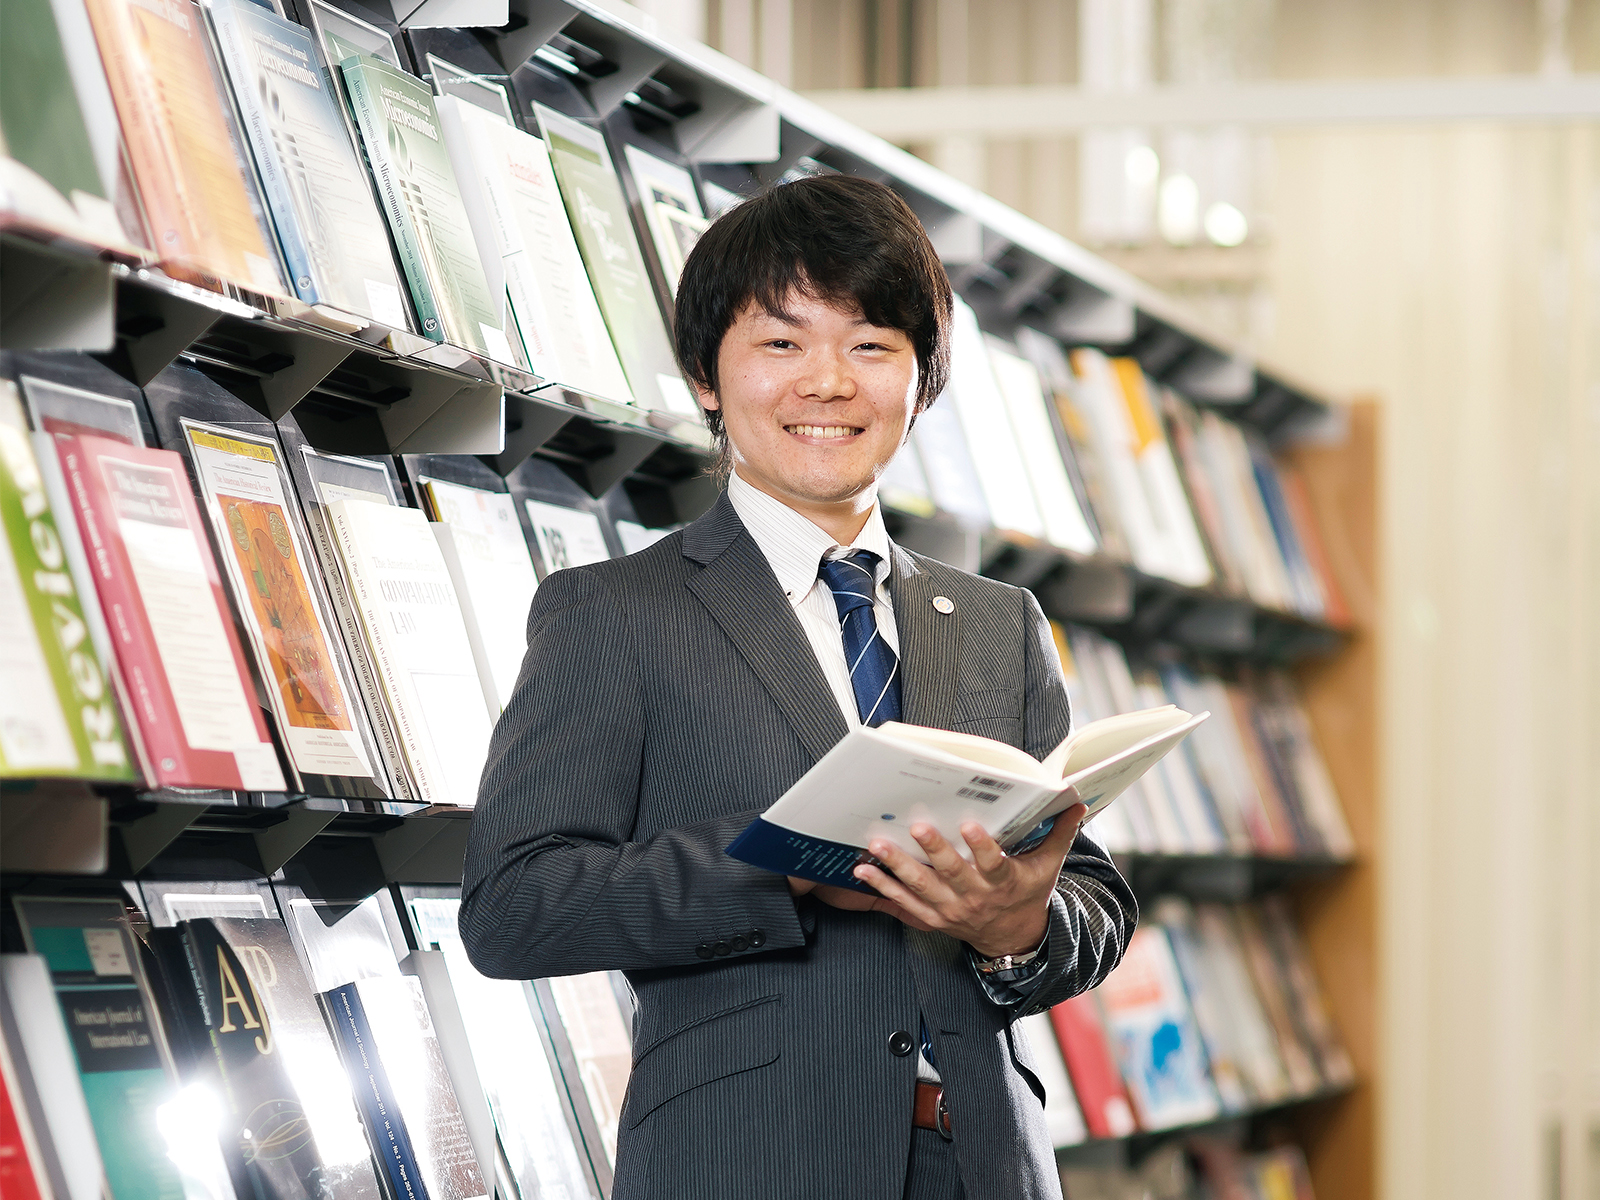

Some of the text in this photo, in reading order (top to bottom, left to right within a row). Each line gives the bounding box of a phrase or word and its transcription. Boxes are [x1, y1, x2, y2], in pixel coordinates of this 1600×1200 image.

[250, 39, 319, 89] Macroeconomics
[222, 21, 236, 52] American
[232, 53, 246, 85] Economic
[242, 85, 254, 110] Journal
[251, 111, 276, 180] Macroeconomics
[380, 84, 402, 101] American
[399, 91, 419, 109] Economic
[379, 95, 438, 142] Microeconomics
[353, 78, 367, 108] American
[362, 108, 376, 139] Economic
[371, 138, 384, 162] Journal
[380, 162, 403, 226] Microeconomics
[400, 229, 409, 249] November
[410, 262, 418, 277] Volume
[417, 284, 425, 301] Number
[528, 325, 544, 357] Annales
[214, 472, 272, 493] The American Historical Review
[65, 452, 114, 579] The American Economic Review
[380, 579, 454, 606] COMPARATIVE
[366, 609, 375, 622] THE
[371, 623, 385, 655] AMERICAN
[381, 654, 394, 683] JOURNAL
[390, 683, 398, 693] OF
[394, 693, 411, 736] COMPARATIVE
[407, 737, 416, 752] LAW
[414, 758, 427, 787] SUMMER
[180, 932, 212, 1026] The American Journal of Psychology
[74, 1006, 107, 1026] American
[106, 1004, 133, 1029] Journal
[339, 991, 352, 1017] American
[134, 1030, 149, 1046] Law
[348, 1016, 359, 1037] Journal
[357, 1043, 370, 1069] Sociology
[367, 1073, 381, 1102] September
[377, 1102, 386, 1116] 2018
[382, 1119, 391, 1130] Vol.
[386, 1130, 395, 1141] 124
[391, 1144, 400, 1155] No.
[397, 1163, 408, 1181] Pages
